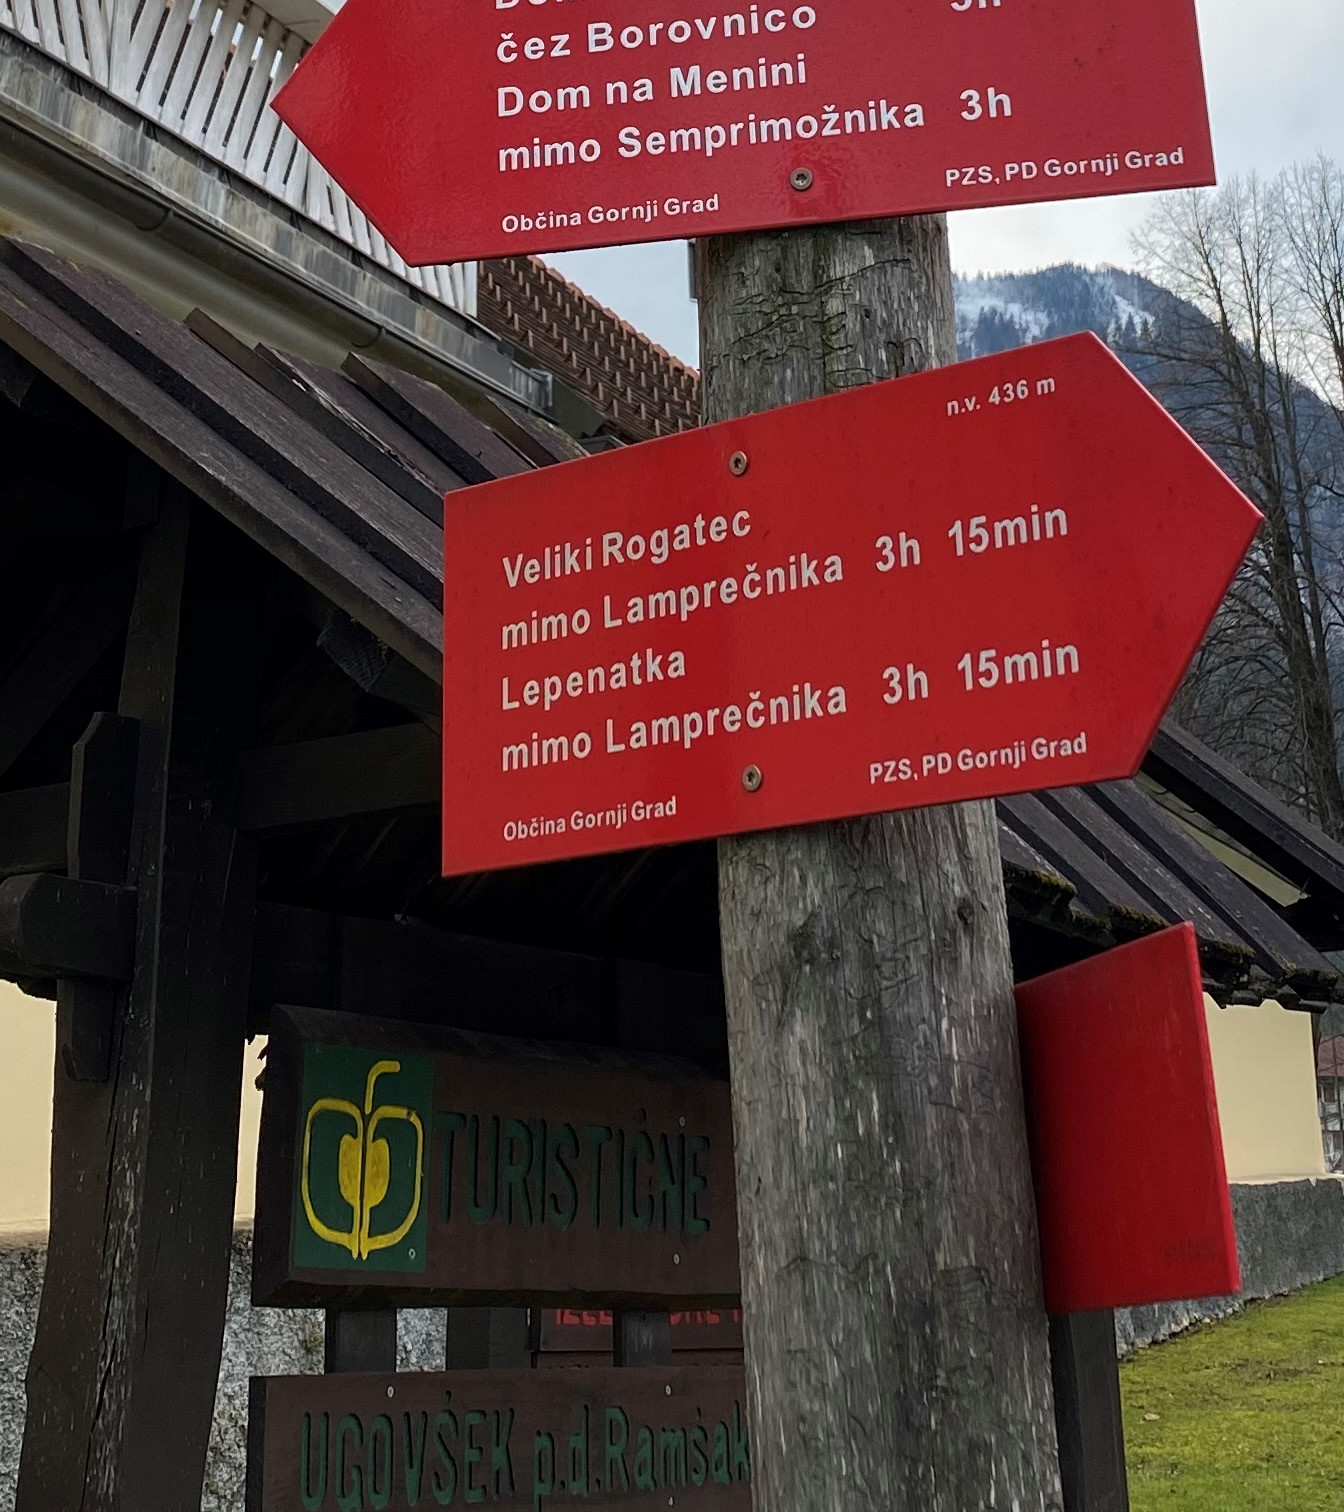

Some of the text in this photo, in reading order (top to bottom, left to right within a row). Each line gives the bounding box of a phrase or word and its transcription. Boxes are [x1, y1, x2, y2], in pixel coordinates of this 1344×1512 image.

[496, 4, 816, 63] čez Borovnico
[497, 52, 806, 118] Dom na Menini
[959, 86, 1012, 121] 3h
[499, 99, 925, 172] mimo Semprimožnika
[1004, 161, 1038, 181] PD
[1043, 152, 1119, 177] Gornji
[1124, 146, 1184, 169] Grad
[501, 193, 719, 233] Občina Gornji Grad
[947, 377, 1055, 416] n.v. 436 m
[502, 510, 751, 588] Veliki Rogatec
[875, 504, 1068, 572] 3h 15min
[502, 552, 844, 650] mimo Lamprečnika
[502, 648, 686, 711] Lepenatka
[882, 639, 1079, 704] 3h 15min
[502, 682, 847, 772] mimo Lamprečnika
[922, 752, 952, 777] PD
[957, 740, 1026, 771] Gornji
[1031, 731, 1087, 760] Grad
[503, 795, 677, 841] Občina Gornji Grad
[434, 1107, 711, 1237] TURISTIČNE
[299, 1390, 516, 1511] UGOVŠEK
